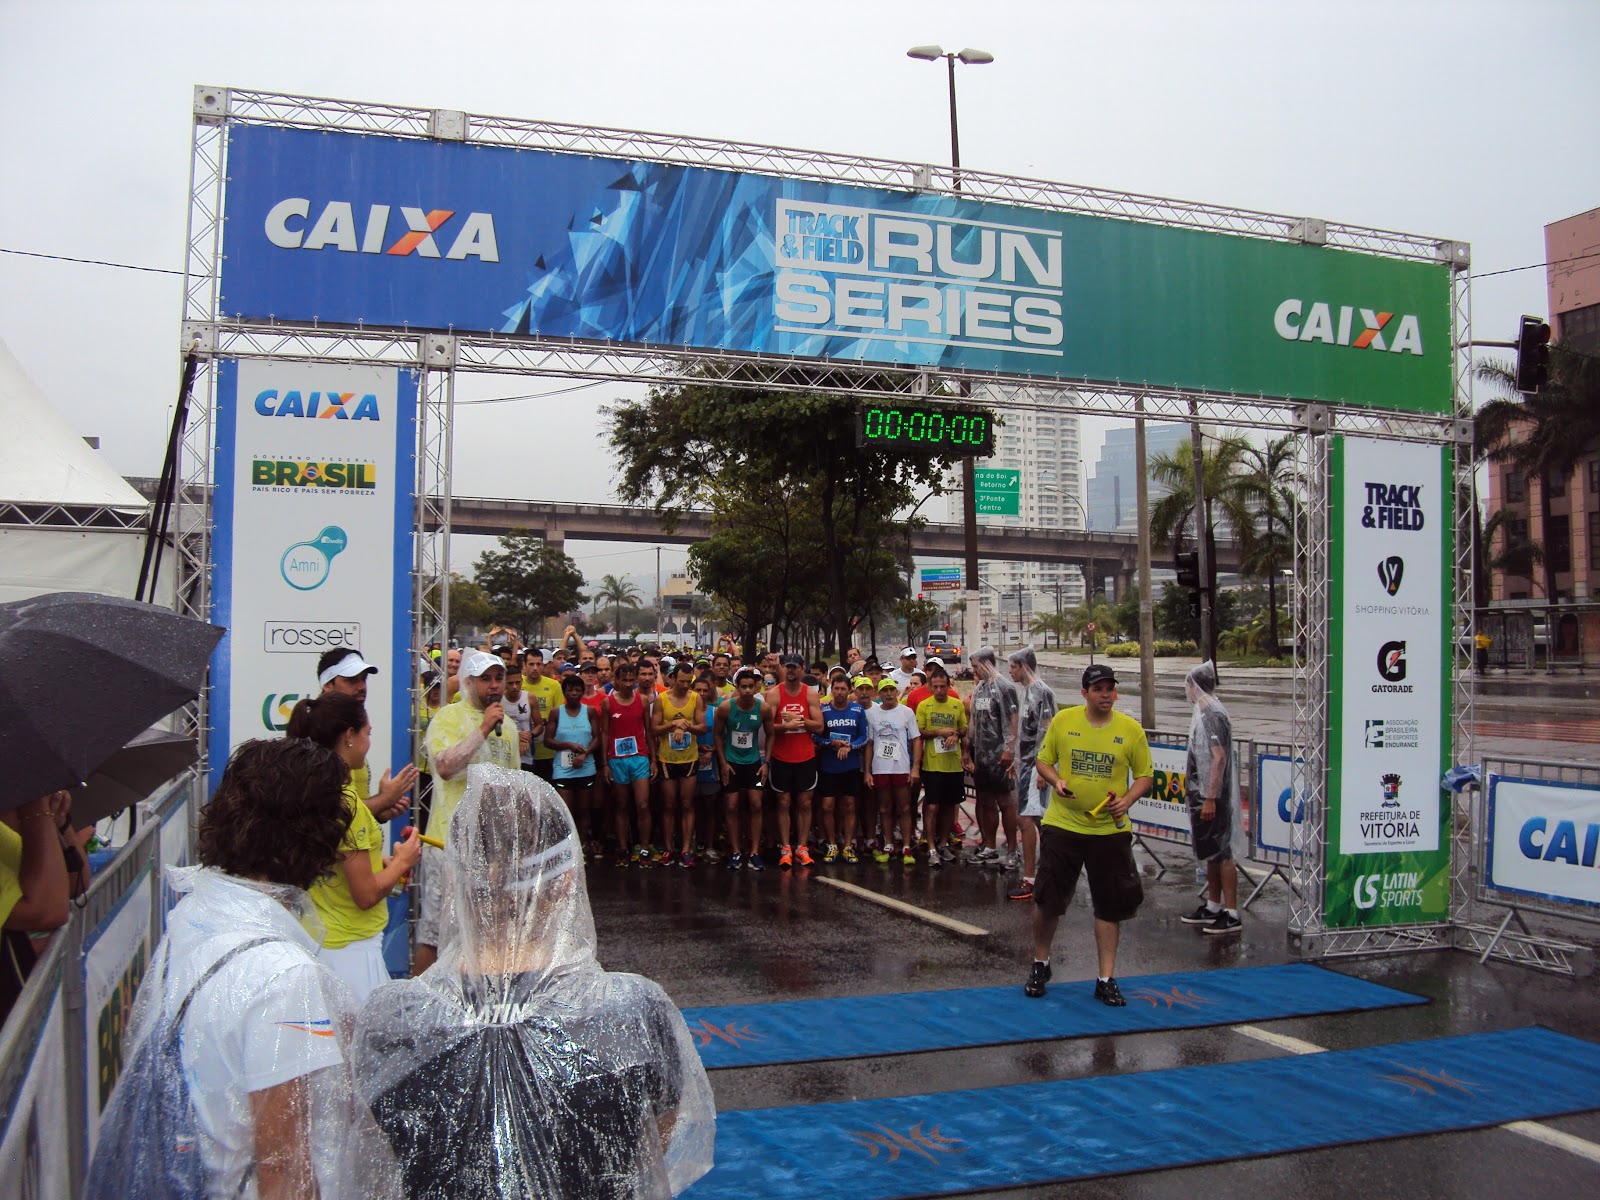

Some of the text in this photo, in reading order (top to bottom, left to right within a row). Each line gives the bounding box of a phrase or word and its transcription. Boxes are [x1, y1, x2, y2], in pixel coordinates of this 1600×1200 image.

[265, 198, 499, 262] CAIXA
[785, 209, 860, 240] TRACK
[803, 236, 864, 264] FIELD
[874, 218, 1063, 287] RUN
[775, 272, 1064, 345] SERIES
[1274, 299, 1423, 356] CAIXA
[254, 389, 380, 421] CAIXA
[865, 409, 986, 444] 00:00:00
[252, 460, 376, 488] BRASIL
[1365, 482, 1420, 508] TRACK
[1378, 507, 1424, 531] FIELD
[290, 558, 320, 572] Amni
[1355, 605, 1397, 614] SHOPPING
[271, 628, 353, 646] rosset
[1371, 685, 1413, 693] GATORADE
[827, 718, 857, 727] BRASIL
[1071, 761, 1112, 773] SERIES
[1085, 752, 1115, 764] RUN
[1361, 811, 1421, 821] PREFEITURA DE
[1361, 820, 1420, 838] VITÓRIA
[1519, 816, 1600, 868] CAI
[1383, 873, 1418, 889] LATIN
[1379, 890, 1424, 908] SPORTS
